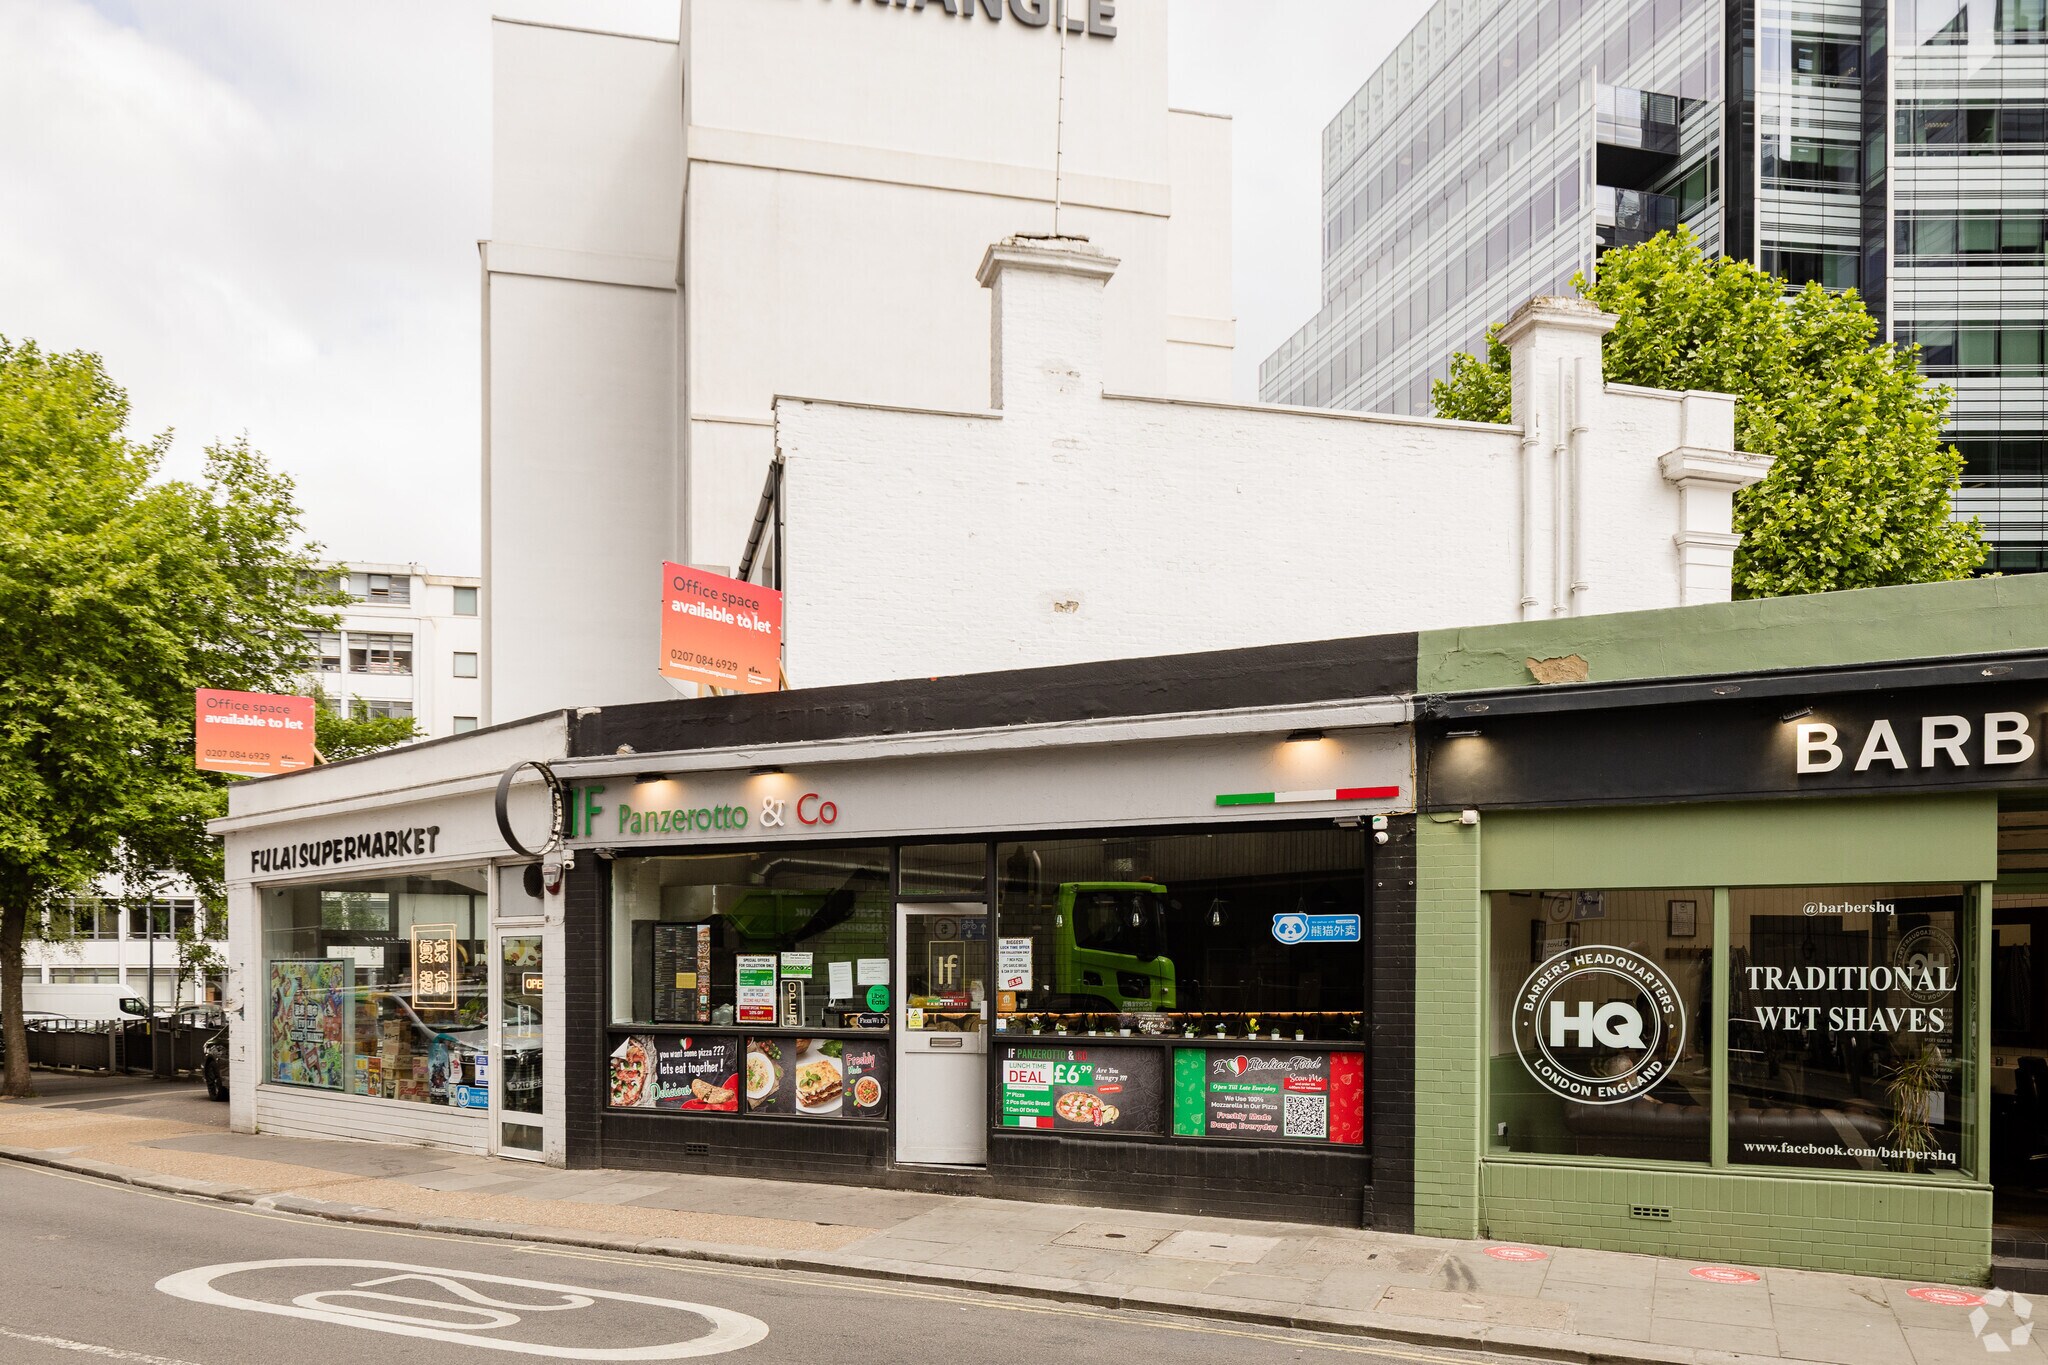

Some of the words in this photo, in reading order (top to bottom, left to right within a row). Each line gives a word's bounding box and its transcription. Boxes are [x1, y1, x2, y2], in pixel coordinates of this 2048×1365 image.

[673, 576, 718, 600] Office
[721, 592, 760, 610] space
[671, 600, 735, 625] available
[736, 614, 752, 629] to
[753, 615, 772, 634] let
[671, 649, 694, 662] 0207
[695, 654, 714, 666] 084
[715, 660, 738, 672] 6929
[206, 697, 249, 711] Office
[253, 704, 291, 714] space
[205, 714, 266, 727] available
[267, 717, 284, 729] to
[285, 717, 304, 730] let
[205, 749, 227, 758] 0207
[229, 750, 247, 759] 084
[248, 752, 271, 760] 6929
[572, 785, 606, 837] IF
[619, 803, 749, 834] Panzerotto
[759, 795, 786, 828] &
[797, 793, 838, 826] Co
[1802, 901, 1895, 917] @barbershq
[1311, 925, 1356, 937] 熊猫外卖
[938, 954, 958, 985] If
[1522, 960, 1571, 1012] BARBERS
[1574, 953, 1675, 1014] HEADQUARTERS
[1745, 966, 1957, 991] TRADITIONAL
[1550, 1001, 1647, 1049] HQ
[1754, 1006, 1821, 1031] WET
[1829, 1007, 1946, 1033] SHAVES
[659, 1051, 669, 1061] you
[670, 1049, 683, 1057] want
[698, 1047, 712, 1059] pizza
[1008, 1048, 1016, 1058] IF
[1017, 1049, 1066, 1059] PANZEROTTO
[1068, 1050, 1075, 1061] &
[1075, 1050, 1088, 1061] CO
[660, 1062, 674, 1075] lets
[675, 1062, 686, 1074] eat
[688, 1060, 718, 1077] together
[1247, 1057, 1292, 1071] Italian
[1289, 1055, 1322, 1070] Food
[1009, 1070, 1047, 1083] DEAL
[1054, 1063, 1092, 1084] £6.99
[1095, 1074, 1119, 1082] Hungry
[1289, 1072, 1308, 1083] Scan
[1308, 1074, 1323, 1082] Me
[1534, 1058, 1591, 1097] LONDON
[1598, 1060, 1663, 1097] ENGLAND
[649, 1081, 692, 1101] Delicious
[1216, 1111, 1247, 1121] Freshly
[1248, 1113, 1272, 1121] Made
[1210, 1121, 1238, 1131] Dough
[1238, 1122, 1279, 1132] Everyday
[1744, 1142, 1957, 1164] www.facebook.com/barbershq
